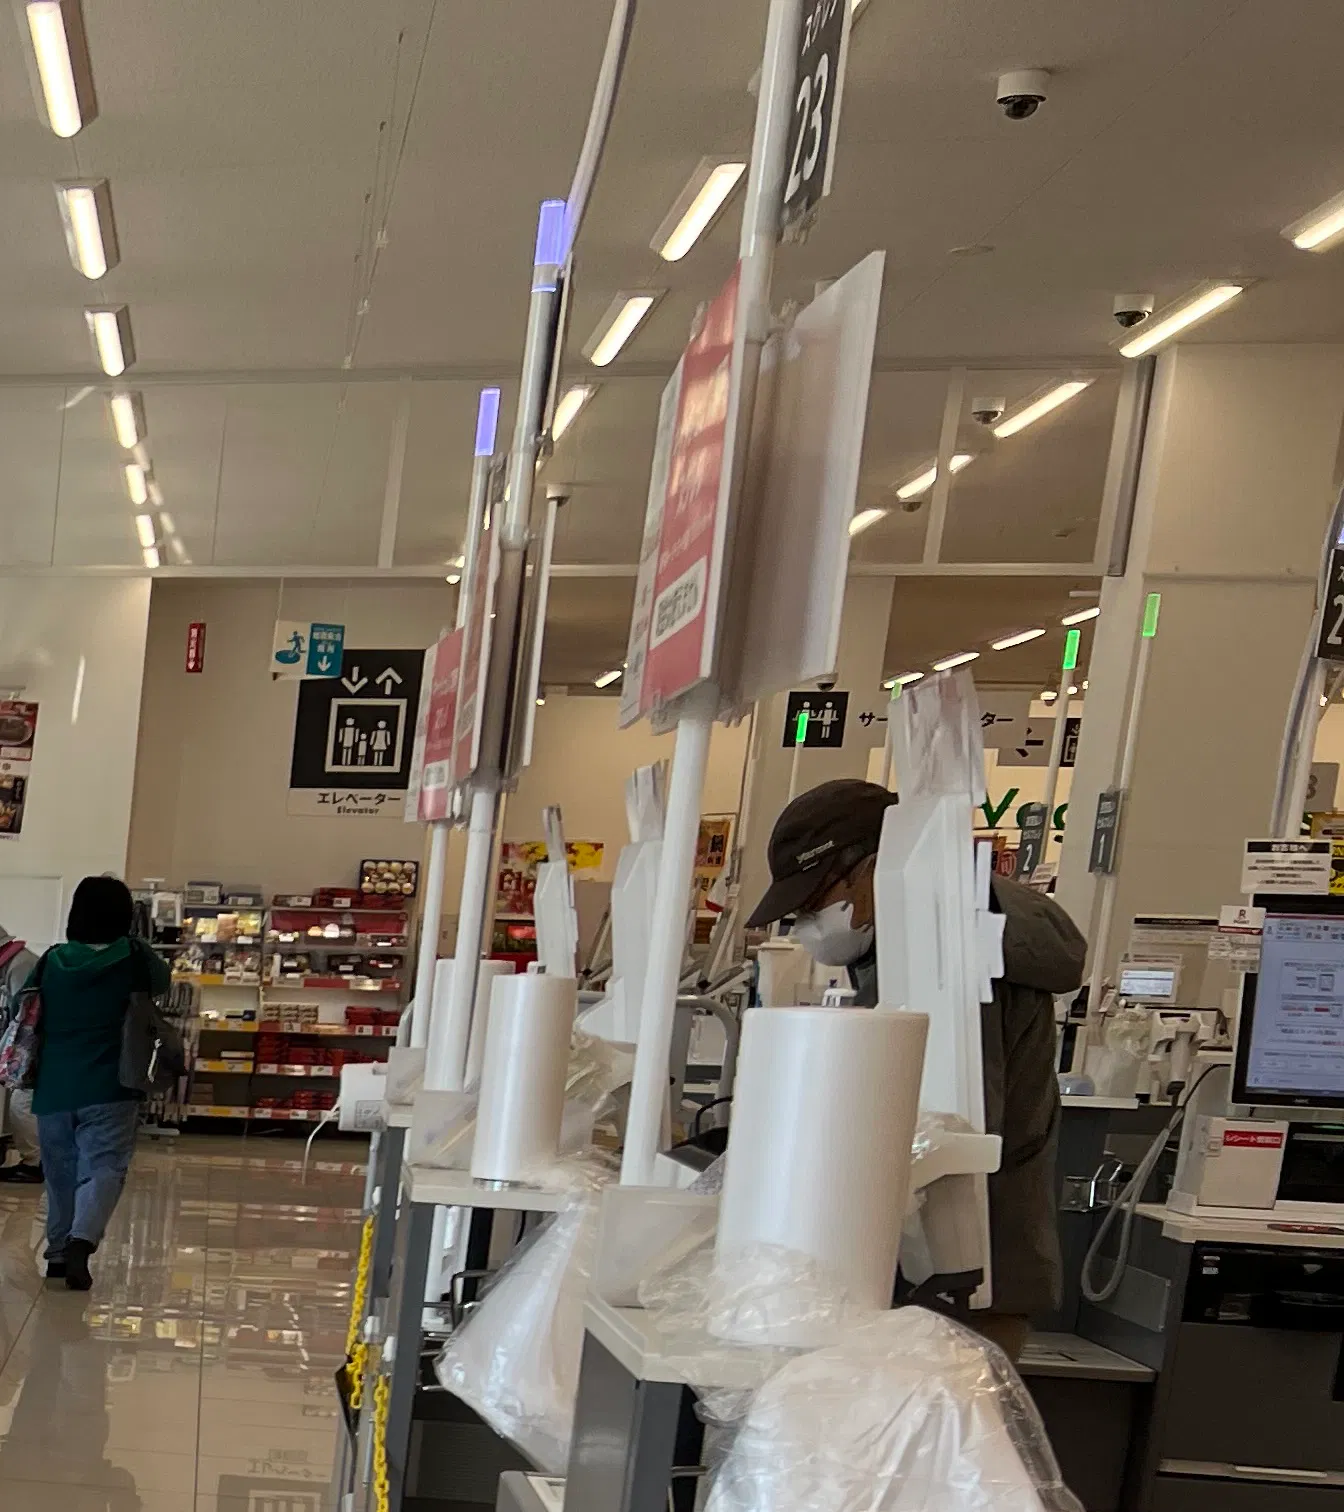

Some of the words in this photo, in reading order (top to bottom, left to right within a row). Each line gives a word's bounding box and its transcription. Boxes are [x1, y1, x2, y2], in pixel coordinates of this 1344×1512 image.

[784, 53, 829, 203] 23
[317, 791, 401, 805] エレベーター
[337, 805, 379, 815] Elevator
[1023, 843, 1033, 872] 2
